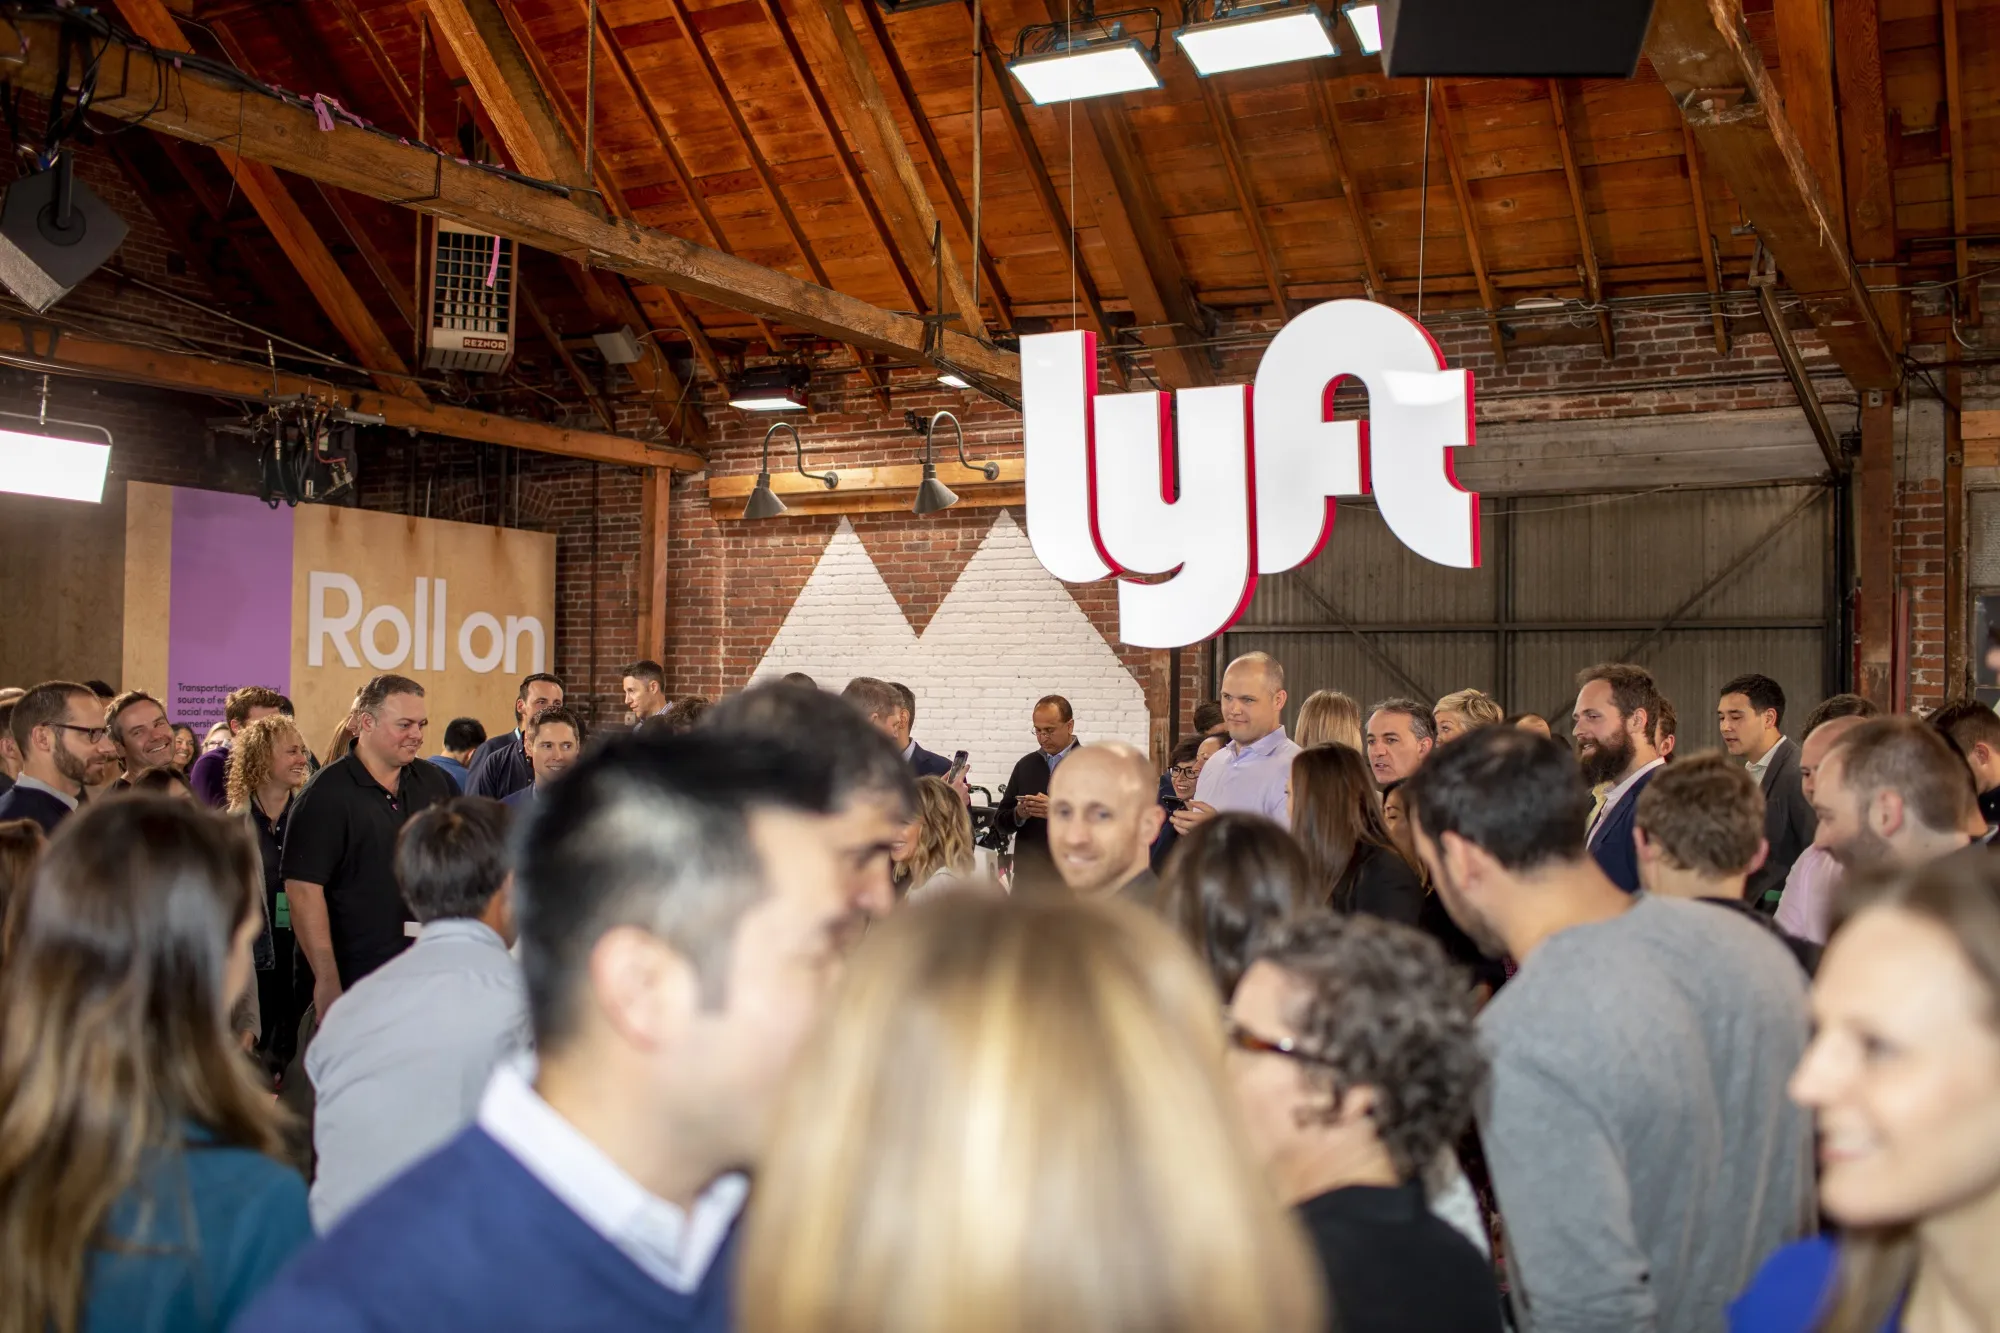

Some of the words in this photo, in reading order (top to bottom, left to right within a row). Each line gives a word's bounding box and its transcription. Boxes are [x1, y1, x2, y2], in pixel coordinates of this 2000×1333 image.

[464, 338, 506, 349] REZNOR
[1019, 298, 1481, 648] lyft
[308, 571, 447, 671] Roll
[458, 611, 545, 674] on
[177, 683, 238, 694] Transportation
[207, 695, 216, 704] of
[177, 706, 201, 716] social
[203, 706, 224, 716] mobi
